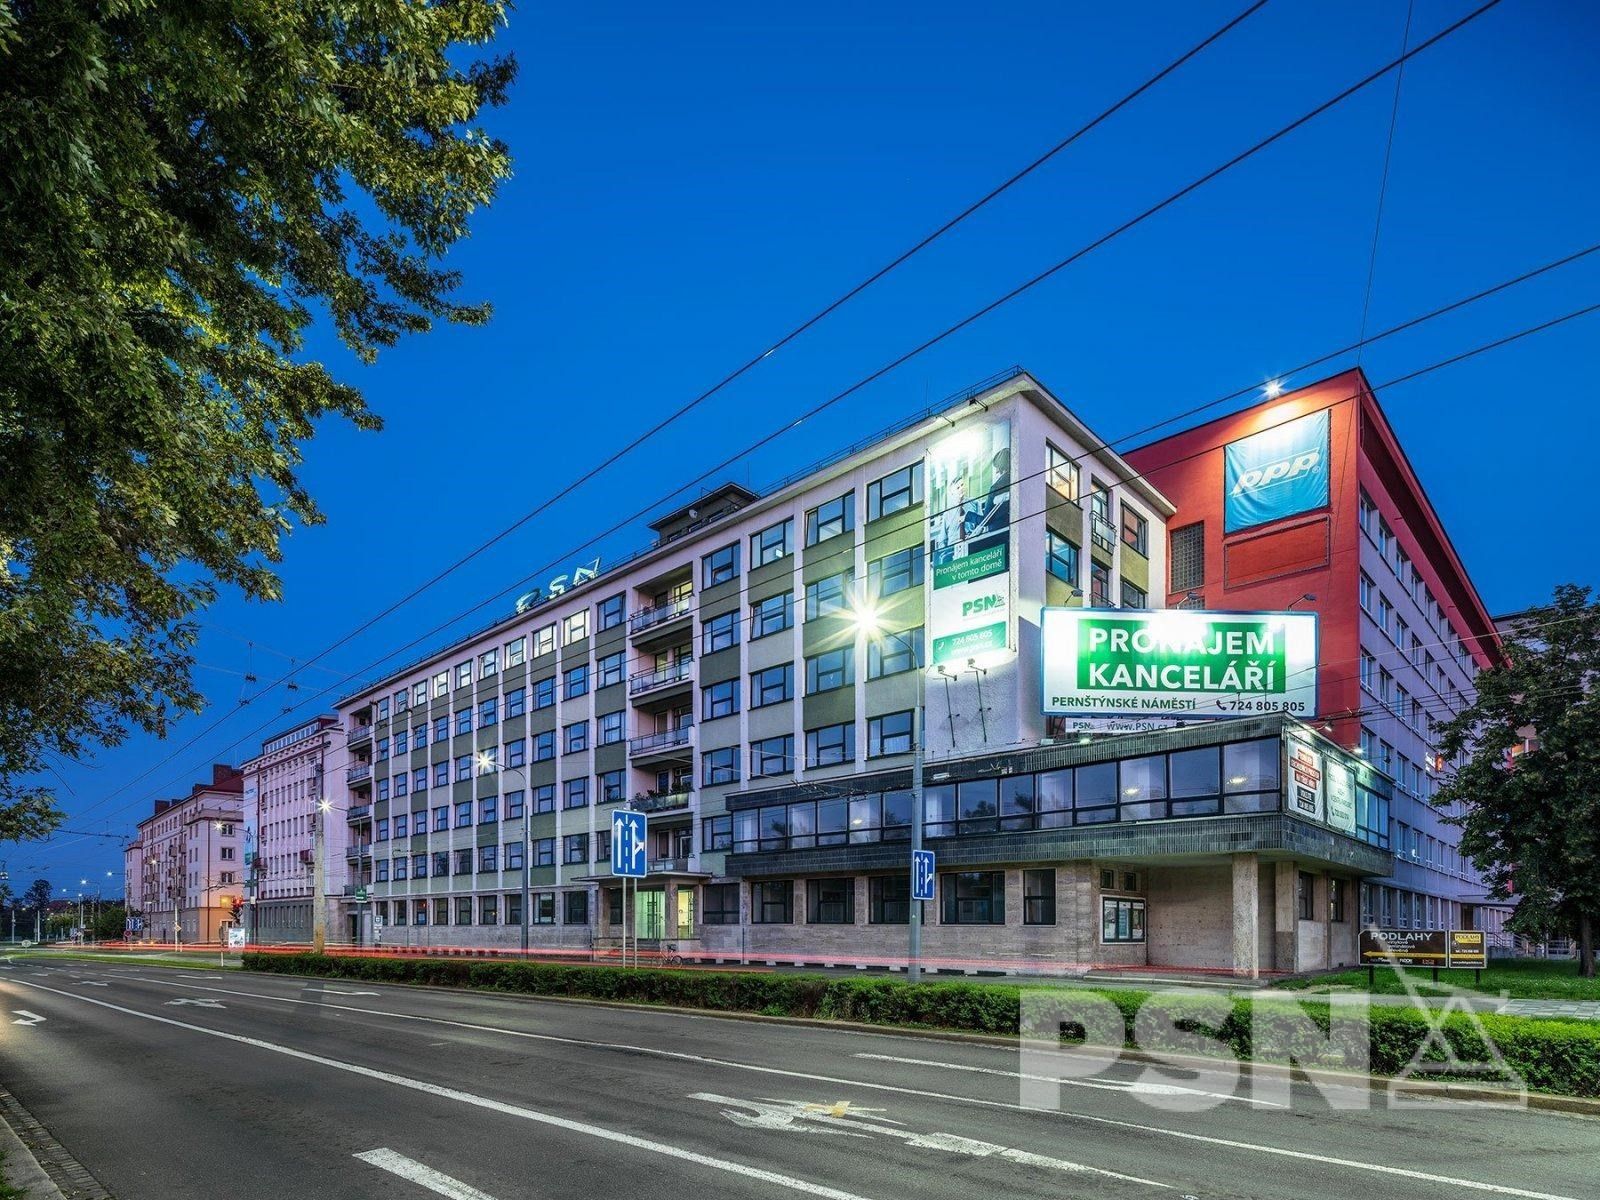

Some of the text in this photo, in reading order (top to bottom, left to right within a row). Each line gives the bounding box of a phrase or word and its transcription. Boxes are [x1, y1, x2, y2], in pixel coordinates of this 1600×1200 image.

[935, 547, 1003, 578] Pronájem kanceláří
[957, 567, 980, 580] tomto
[980, 560, 1003, 573] domě
[962, 594, 997, 617] PSN
[1089, 660, 1277, 691] KANCELÁŘÍ
[1051, 693, 1196, 711] PERNŠTÝNSKÉ NÁMĚSTÍ
[1229, 700, 1306, 713] 724 805 805
[1072, 721, 1091, 729] PSN
[1370, 932, 1433, 941] PODLAHY
